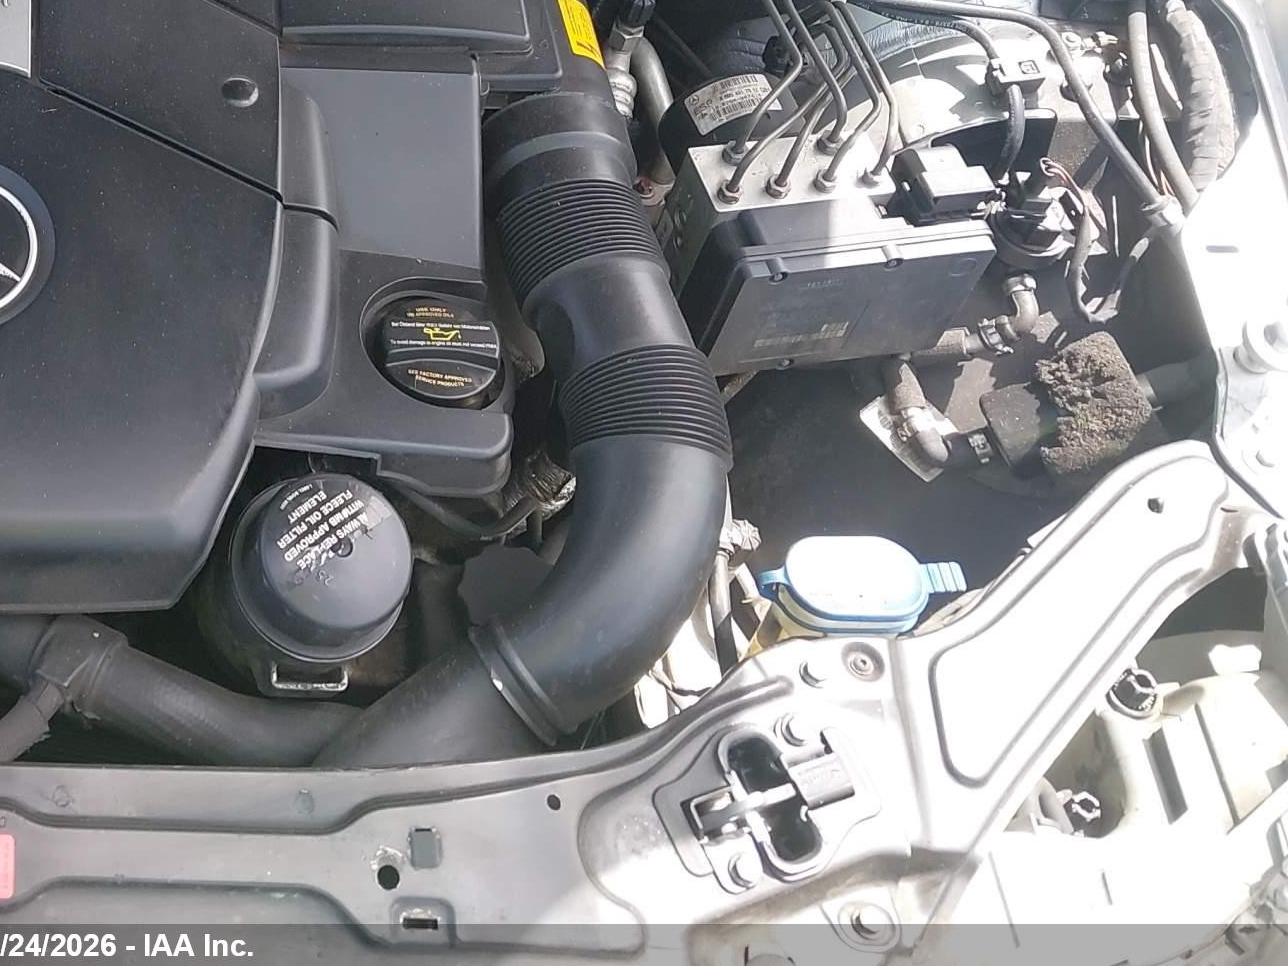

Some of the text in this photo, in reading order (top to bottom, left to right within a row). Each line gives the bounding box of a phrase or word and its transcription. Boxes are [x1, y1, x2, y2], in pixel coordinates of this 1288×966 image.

[693, 99, 713, 116] ESP
[419, 370, 444, 379] FACTORY
[444, 374, 472, 383] APPROVED
[437, 379, 465, 387] PRODUCTS
[287, 490, 328, 524] ELEMENT
[319, 490, 353, 516] FLEECE
[305, 511, 322, 525] OIL
[276, 521, 308, 549] FILTER
[284, 521, 330, 562] APPROVED
